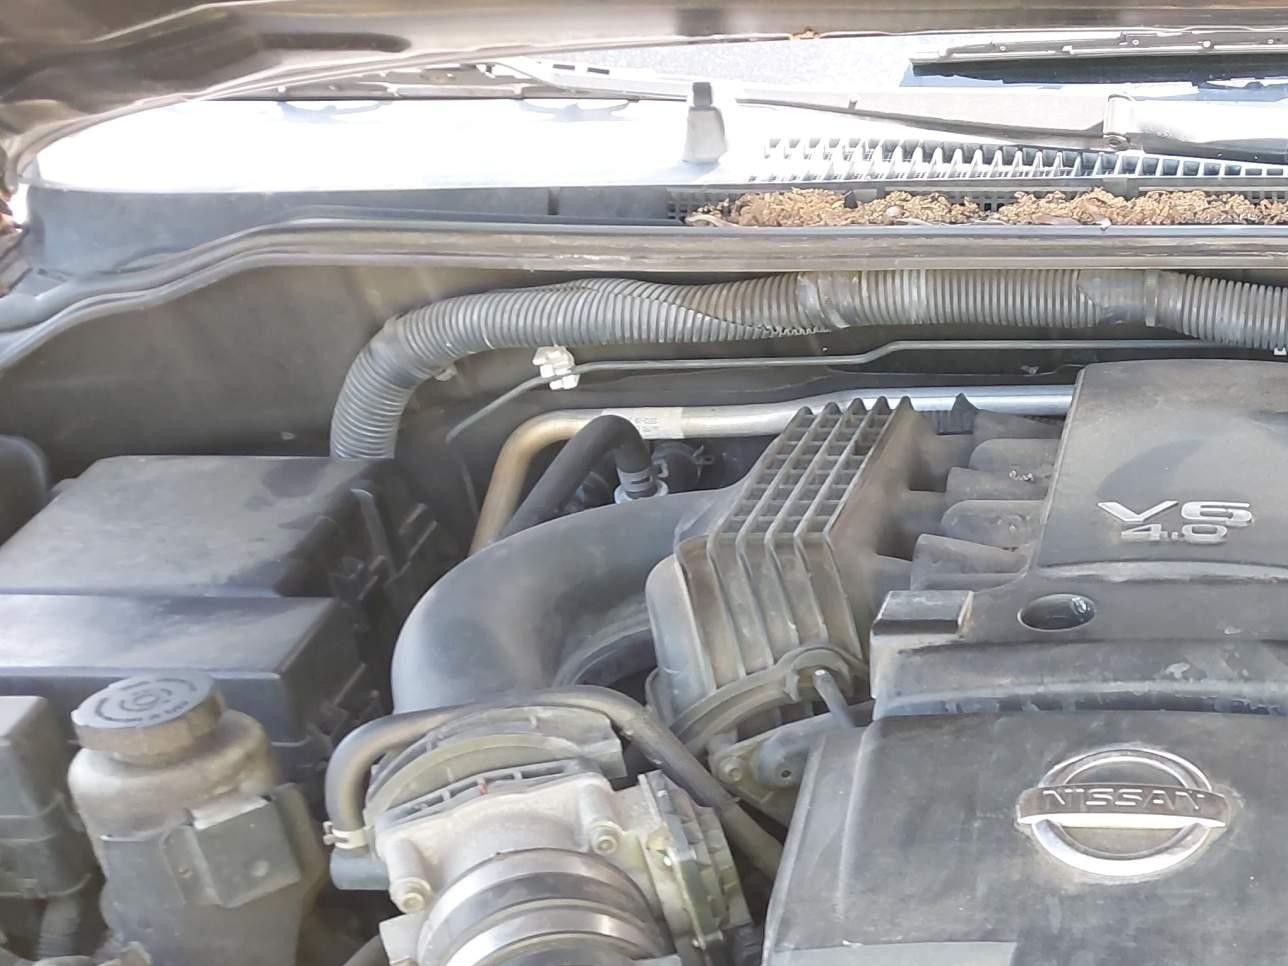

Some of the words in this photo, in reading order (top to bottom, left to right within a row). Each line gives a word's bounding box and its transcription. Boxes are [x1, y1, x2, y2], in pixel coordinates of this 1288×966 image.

[1097, 500, 1254, 526] V6
[1120, 523, 1229, 545] 4.0
[1042, 787, 1206, 811] NISSAN
